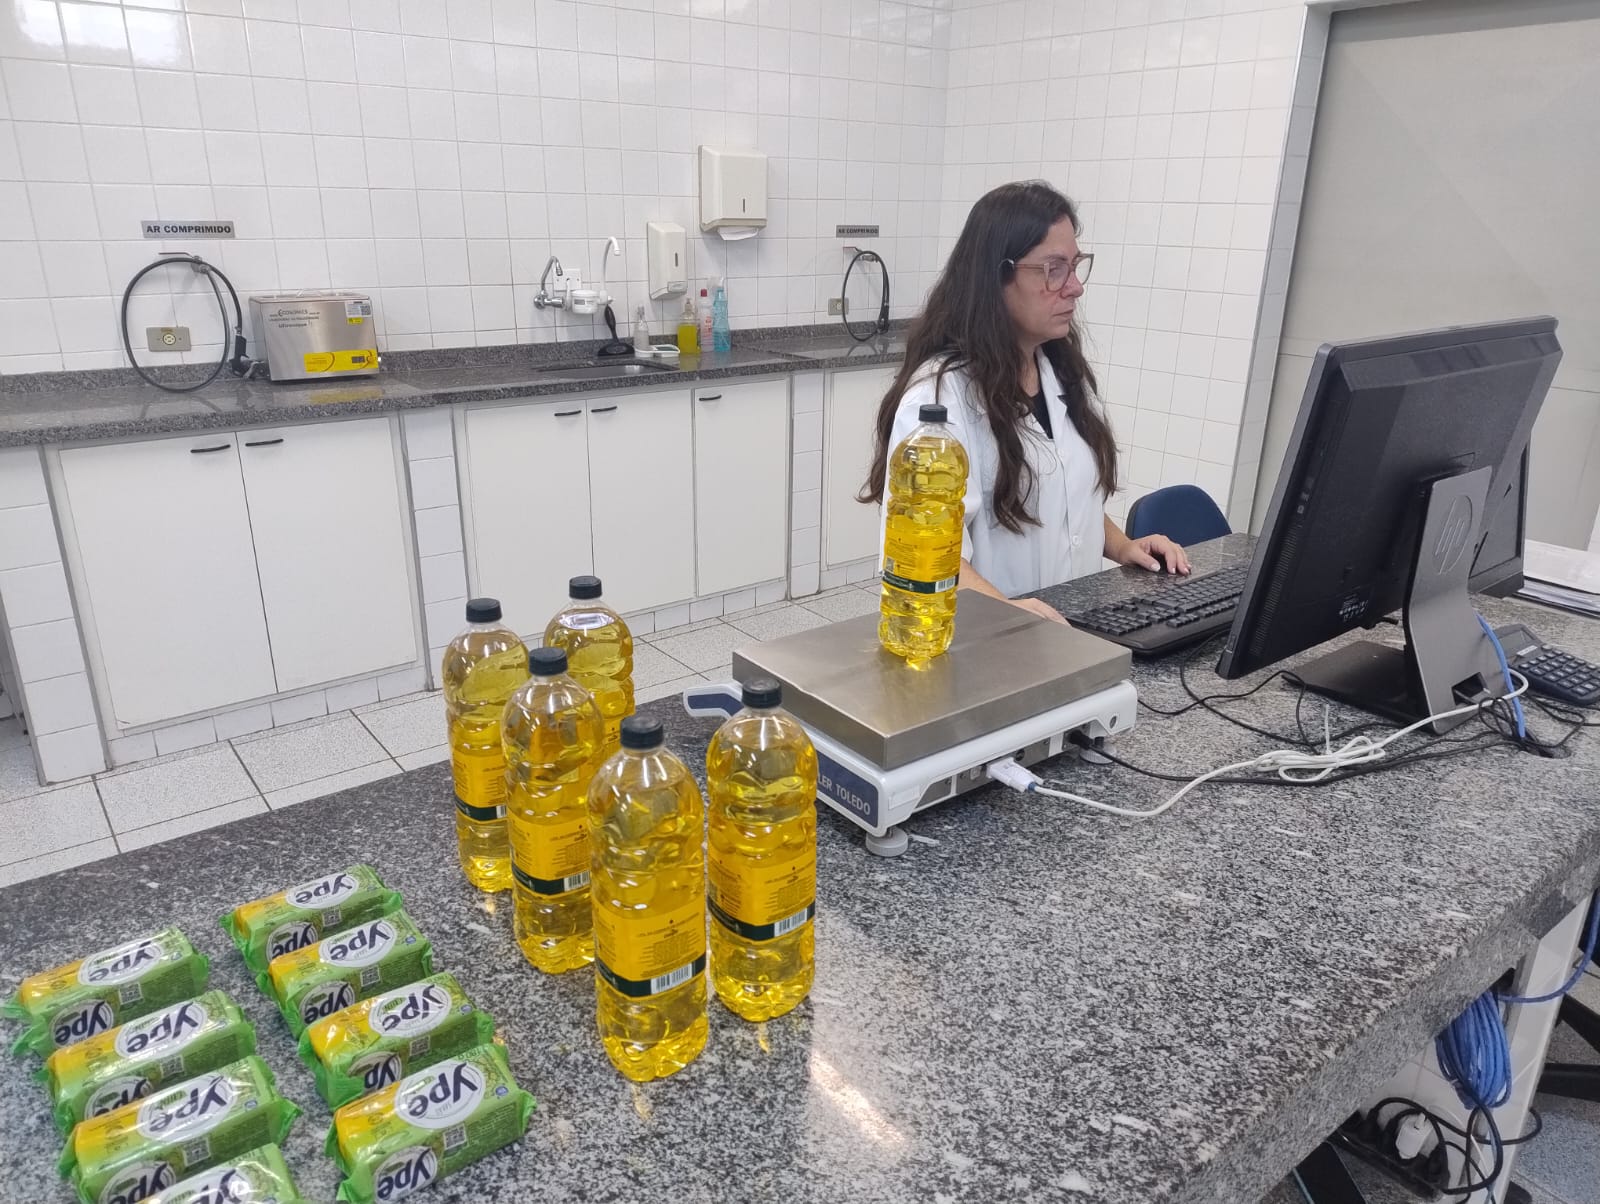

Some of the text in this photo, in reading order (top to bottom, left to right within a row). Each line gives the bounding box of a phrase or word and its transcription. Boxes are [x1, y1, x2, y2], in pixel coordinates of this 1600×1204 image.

[146, 225, 232, 234] AR COMPRIMIDO
[835, 783, 871, 816] TOLEDO
